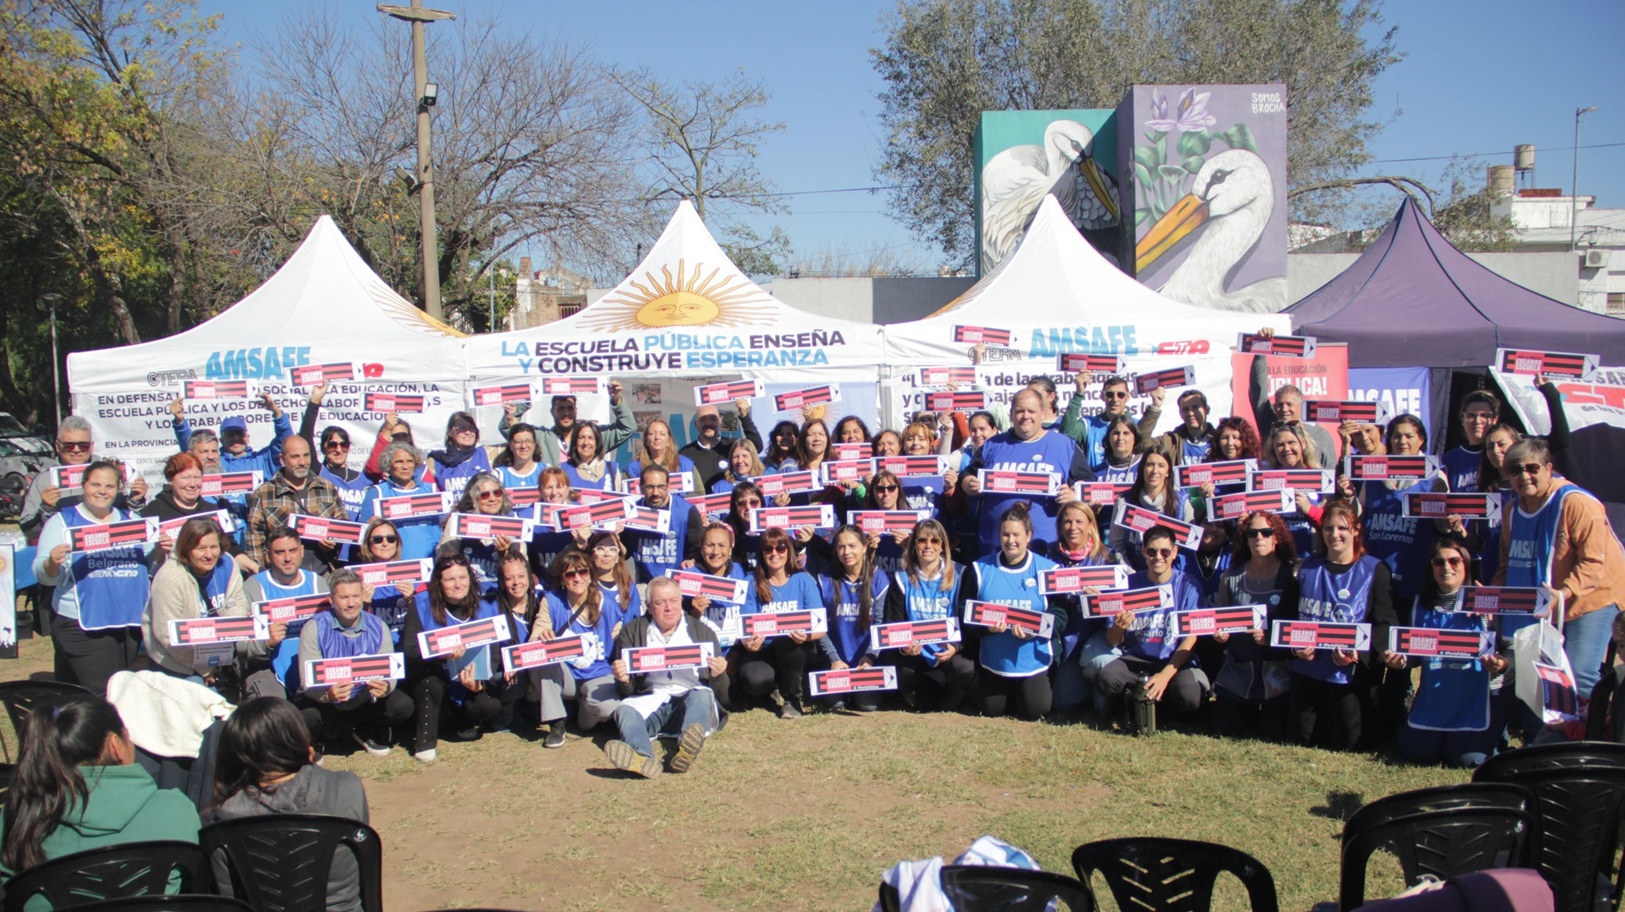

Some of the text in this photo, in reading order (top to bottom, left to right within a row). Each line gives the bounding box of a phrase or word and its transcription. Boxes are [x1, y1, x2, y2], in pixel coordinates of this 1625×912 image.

[1252, 92, 1280, 103] SOMOS
[1252, 102, 1286, 114] BROCHA
[502, 330, 846, 356] LA ESCUELA PÚBLICA ENSEÑA
[1028, 325, 1138, 358] AMSAFE
[206, 346, 312, 380] AMSAFE
[518, 348, 828, 374] Y CONSTRUYE ESPERANZA
[1272, 364, 1327, 375] LA EDUCACIÓN
[994, 372, 1014, 386] de
[423, 384, 440, 393] LA
[98, 396, 114, 405] EN
[116, 392, 173, 404] DEFENSA
[1348, 388, 1420, 417] MSAFE
[98, 402, 246, 418] ESCUELA PÚLICA Y LOS
[145, 421, 154, 430] Y
[132, 438, 179, 448] PROVINCIA
[1370, 513, 1418, 534] AMSAFE
[1368, 532, 1414, 544] San Lorenzo
[88, 558, 138, 568] Belgrano
[762, 600, 798, 612] AMSAFE
[1298, 598, 1332, 618] MSAFE
[272, 611, 296, 619] ESCUELA
[1409, 643, 1437, 651] ESCUELA
[522, 649, 546, 658] CREAMOS
[522, 654, 546, 664] ESCUELA
[326, 672, 351, 680] ESCUELA
